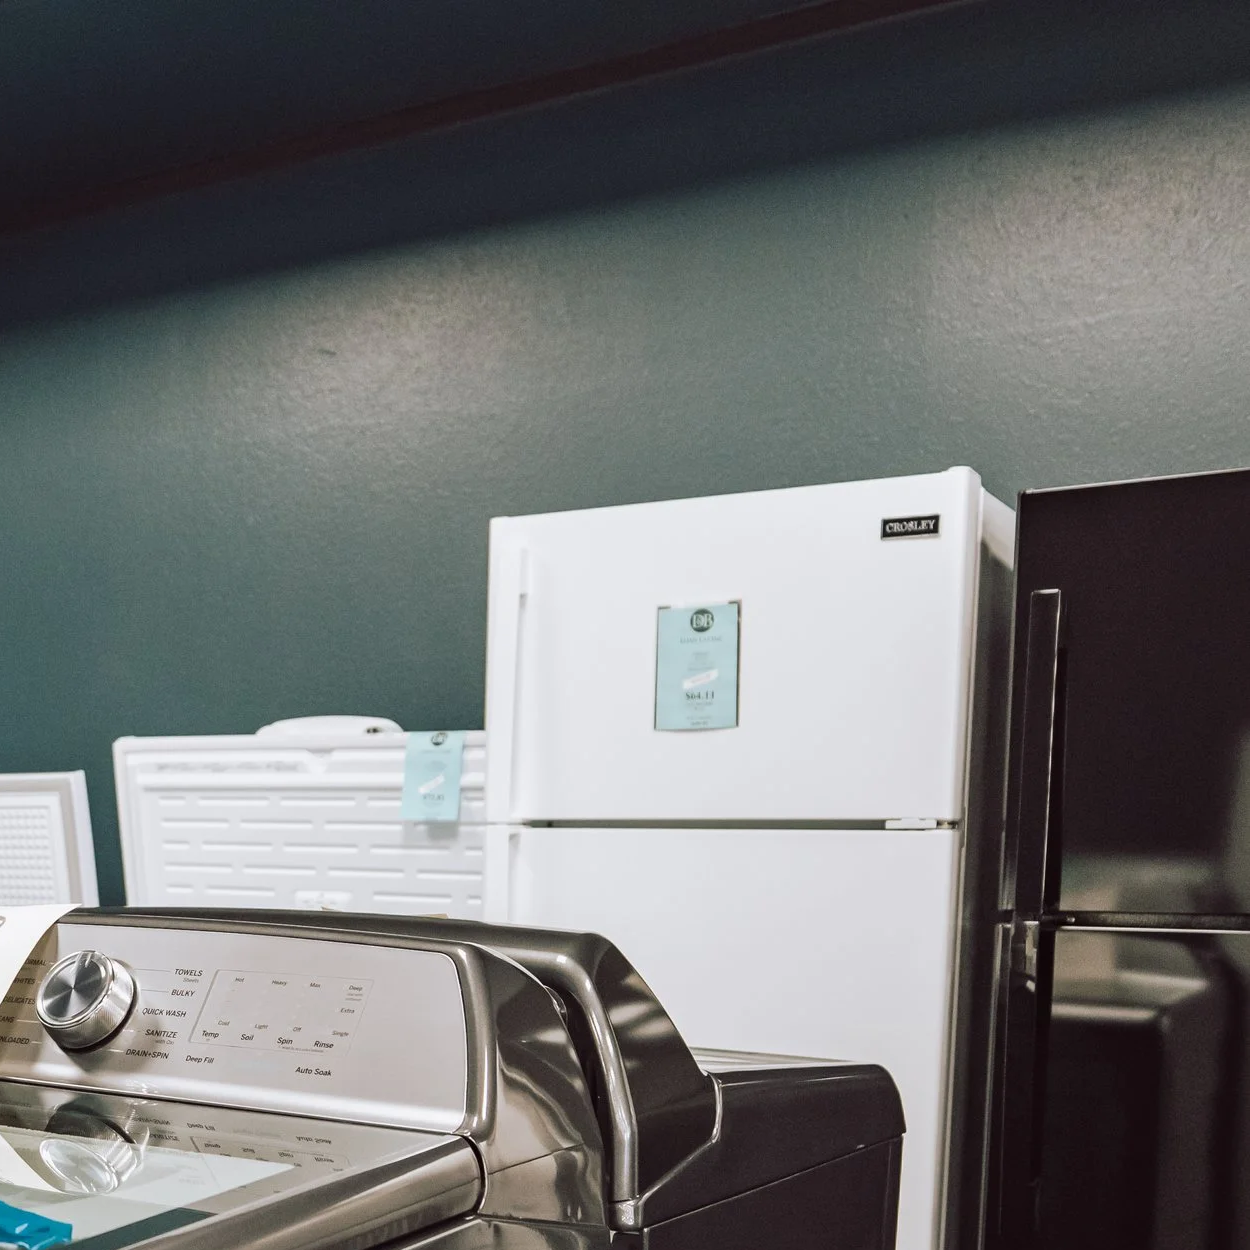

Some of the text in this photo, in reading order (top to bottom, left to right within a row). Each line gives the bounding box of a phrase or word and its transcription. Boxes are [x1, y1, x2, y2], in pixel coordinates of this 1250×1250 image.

[885, 519, 935, 533] CROSLEY
[174, 968, 203, 977] TOWELS
[171, 989, 195, 997] BULKY
[142, 1007, 187, 1018] QUICK WASH
[144, 1029, 178, 1038] SANITIZE
[202, 1030, 219, 1039] Temp
[240, 1033, 254, 1041] Soil
[277, 1037, 293, 1045] Spin
[314, 1040, 334, 1049] Rinse
[125, 1049, 169, 1059] DRAIN+SPIN
[185, 1055, 203, 1063] Deep
[295, 1066, 332, 1077] Auto Soak
